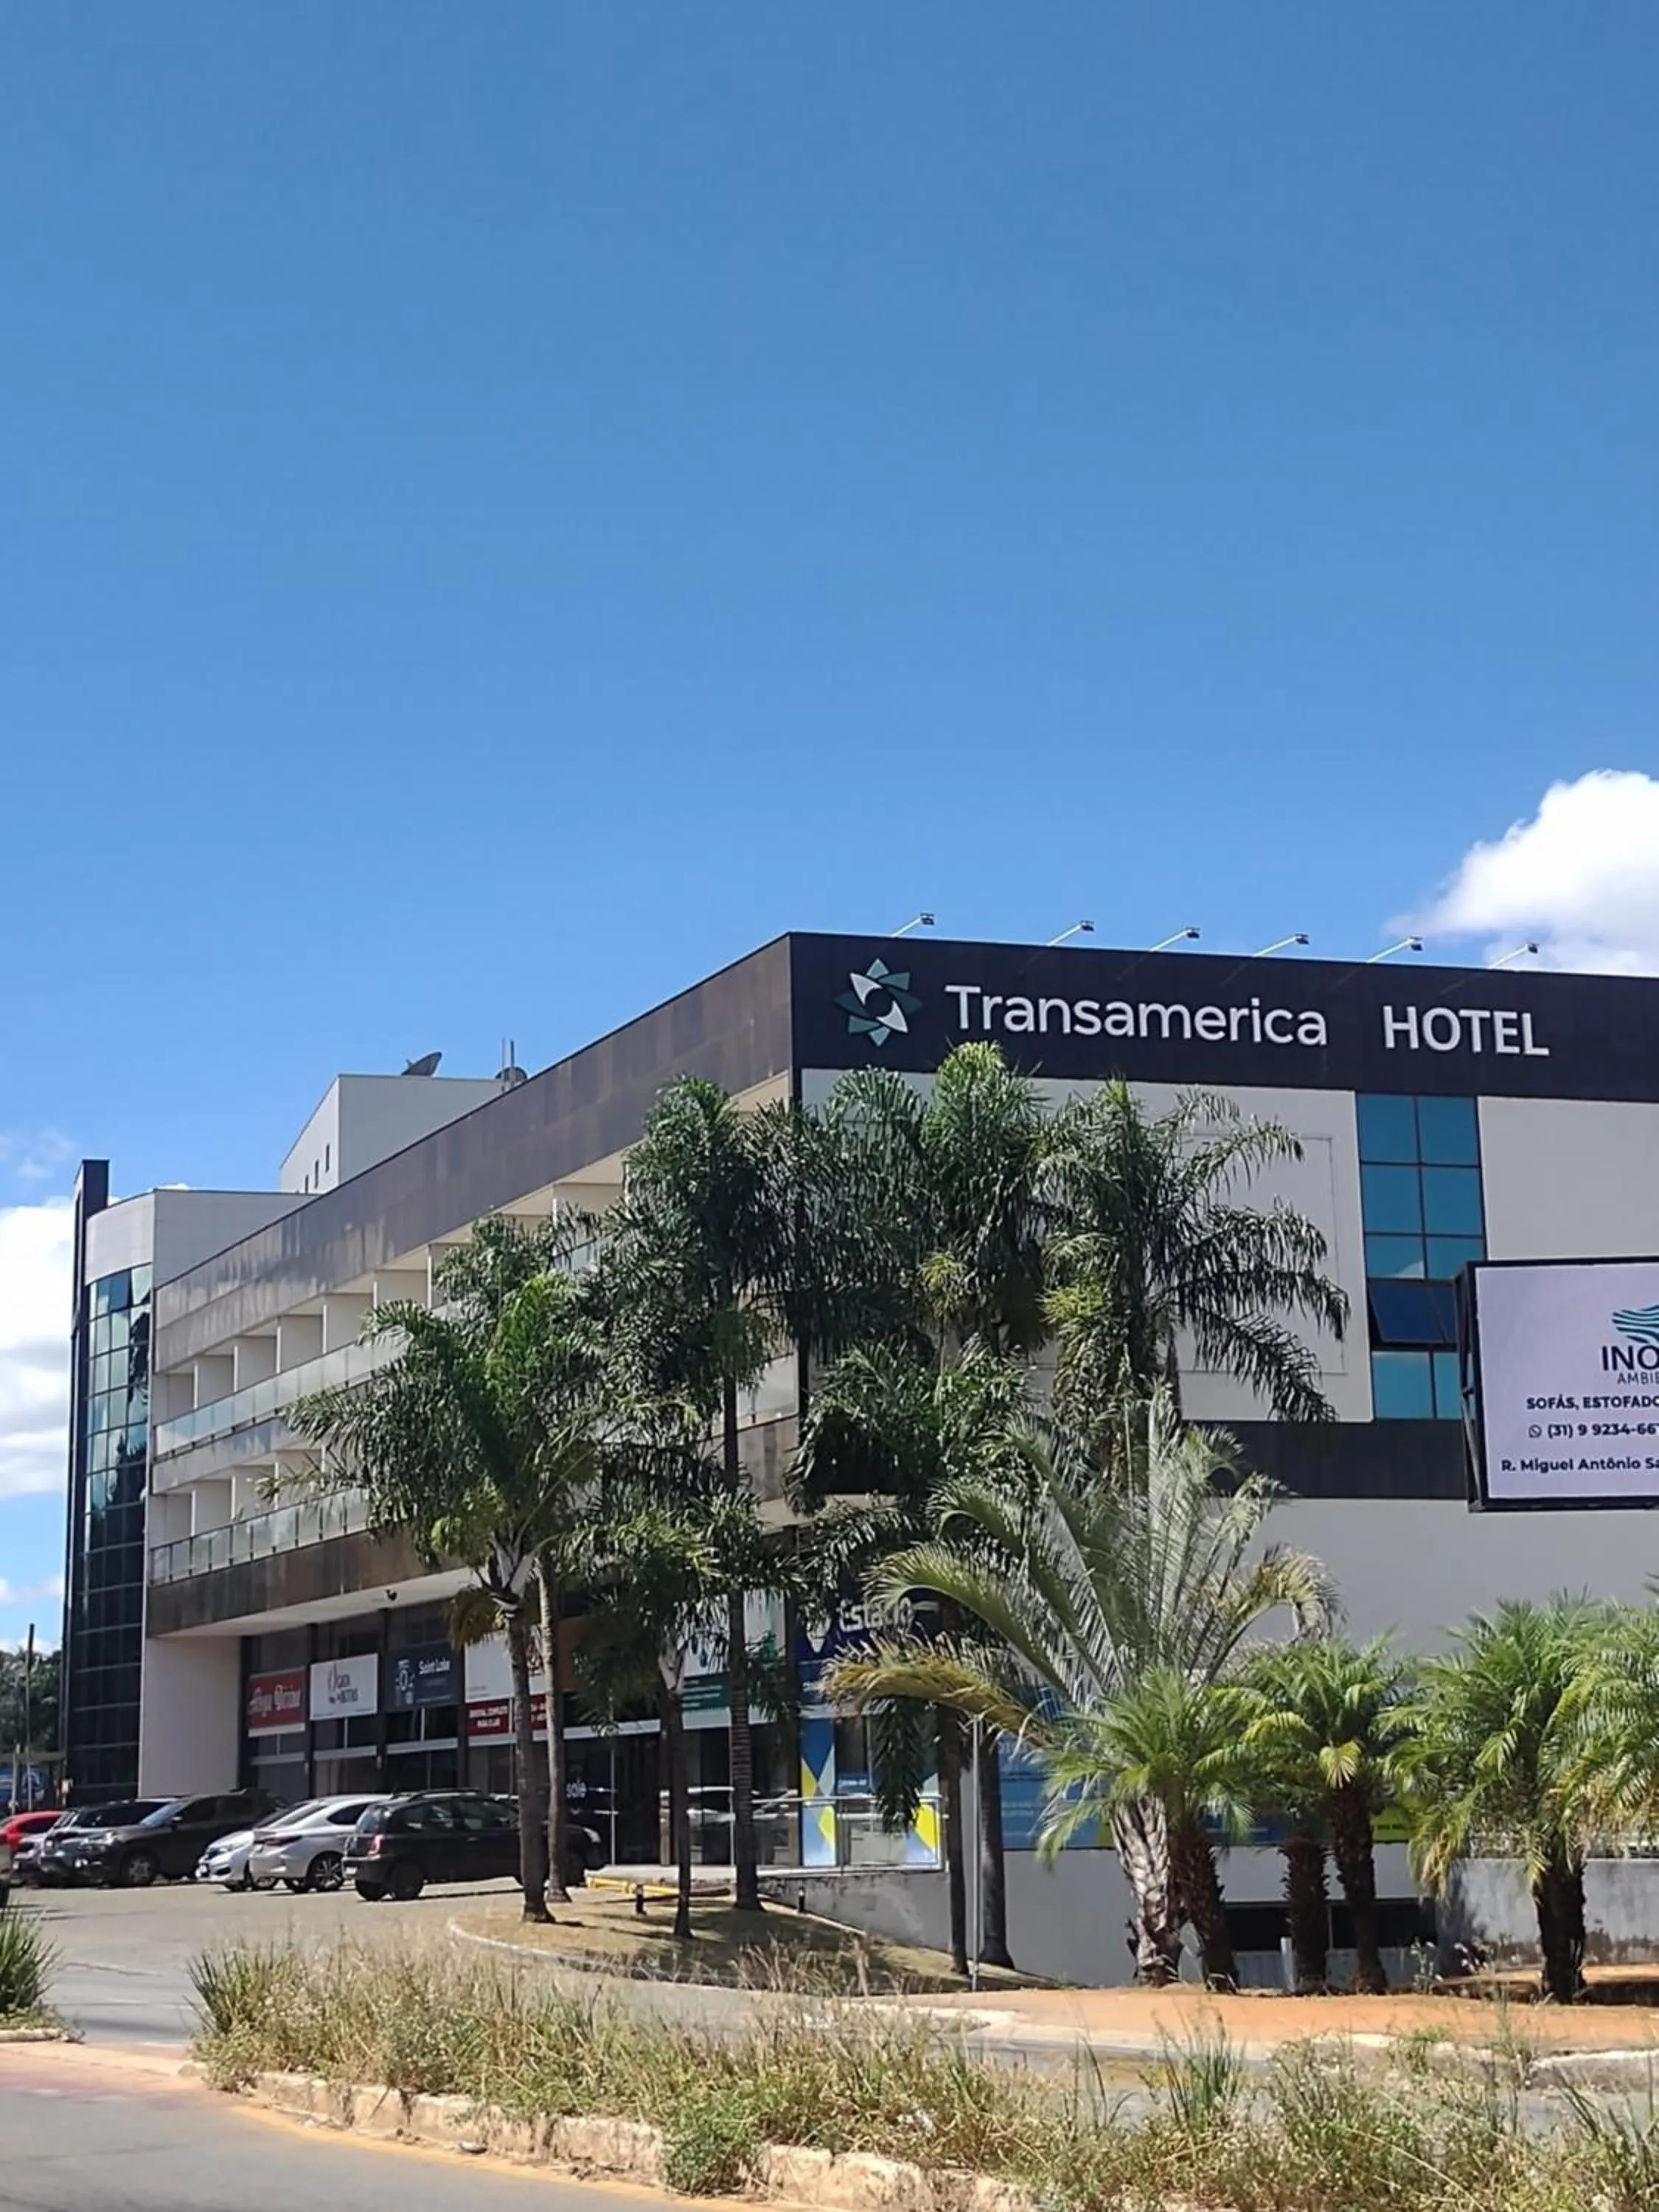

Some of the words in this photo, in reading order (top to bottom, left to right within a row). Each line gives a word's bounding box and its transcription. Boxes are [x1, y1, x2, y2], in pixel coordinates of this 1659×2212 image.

[945, 984, 1327, 1046] Transamerica
[1383, 1004, 1551, 1056] HOTEL
[1526, 1394, 1579, 1411] SOFÁS,
[1547, 1424, 1573, 1439] (31)
[1577, 1424, 1587, 1436] 9
[1501, 1459, 1517, 1472] R.
[1520, 1457, 1574, 1474] Miguel
[1577, 1456, 1641, 1470] Antônio
